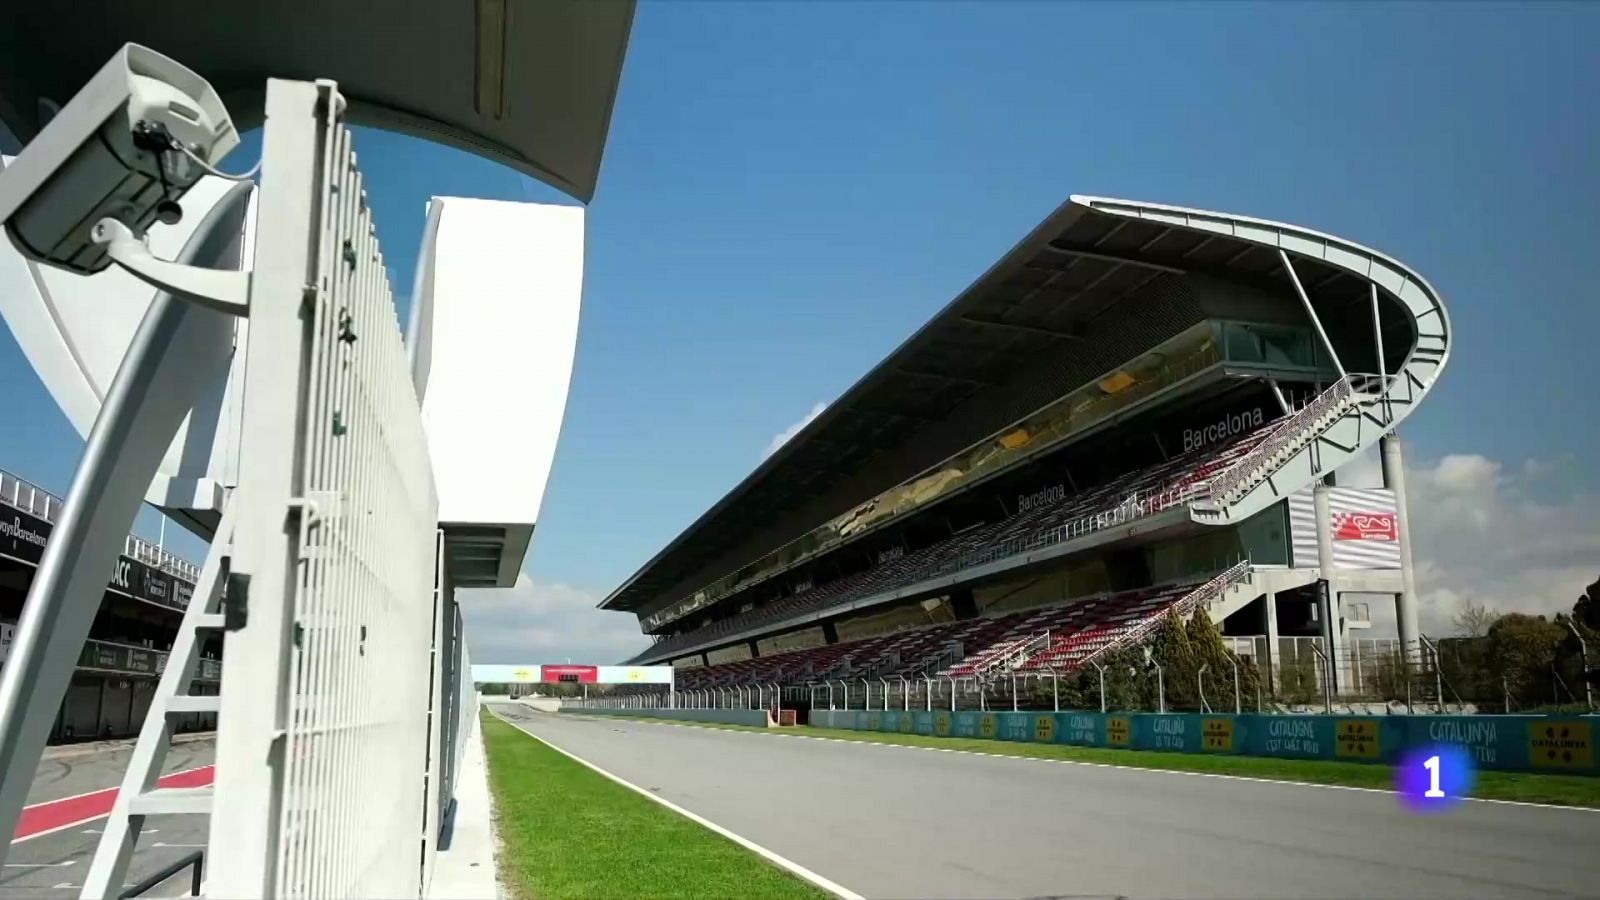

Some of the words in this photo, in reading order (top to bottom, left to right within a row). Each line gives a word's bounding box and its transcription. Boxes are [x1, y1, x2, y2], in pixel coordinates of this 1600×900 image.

[1183, 407, 1264, 453] Barcelona
[1018, 484, 1065, 513] Barcelona
[111, 560, 131, 588] ACC
[1429, 720, 1497, 746] CATALUNYA
